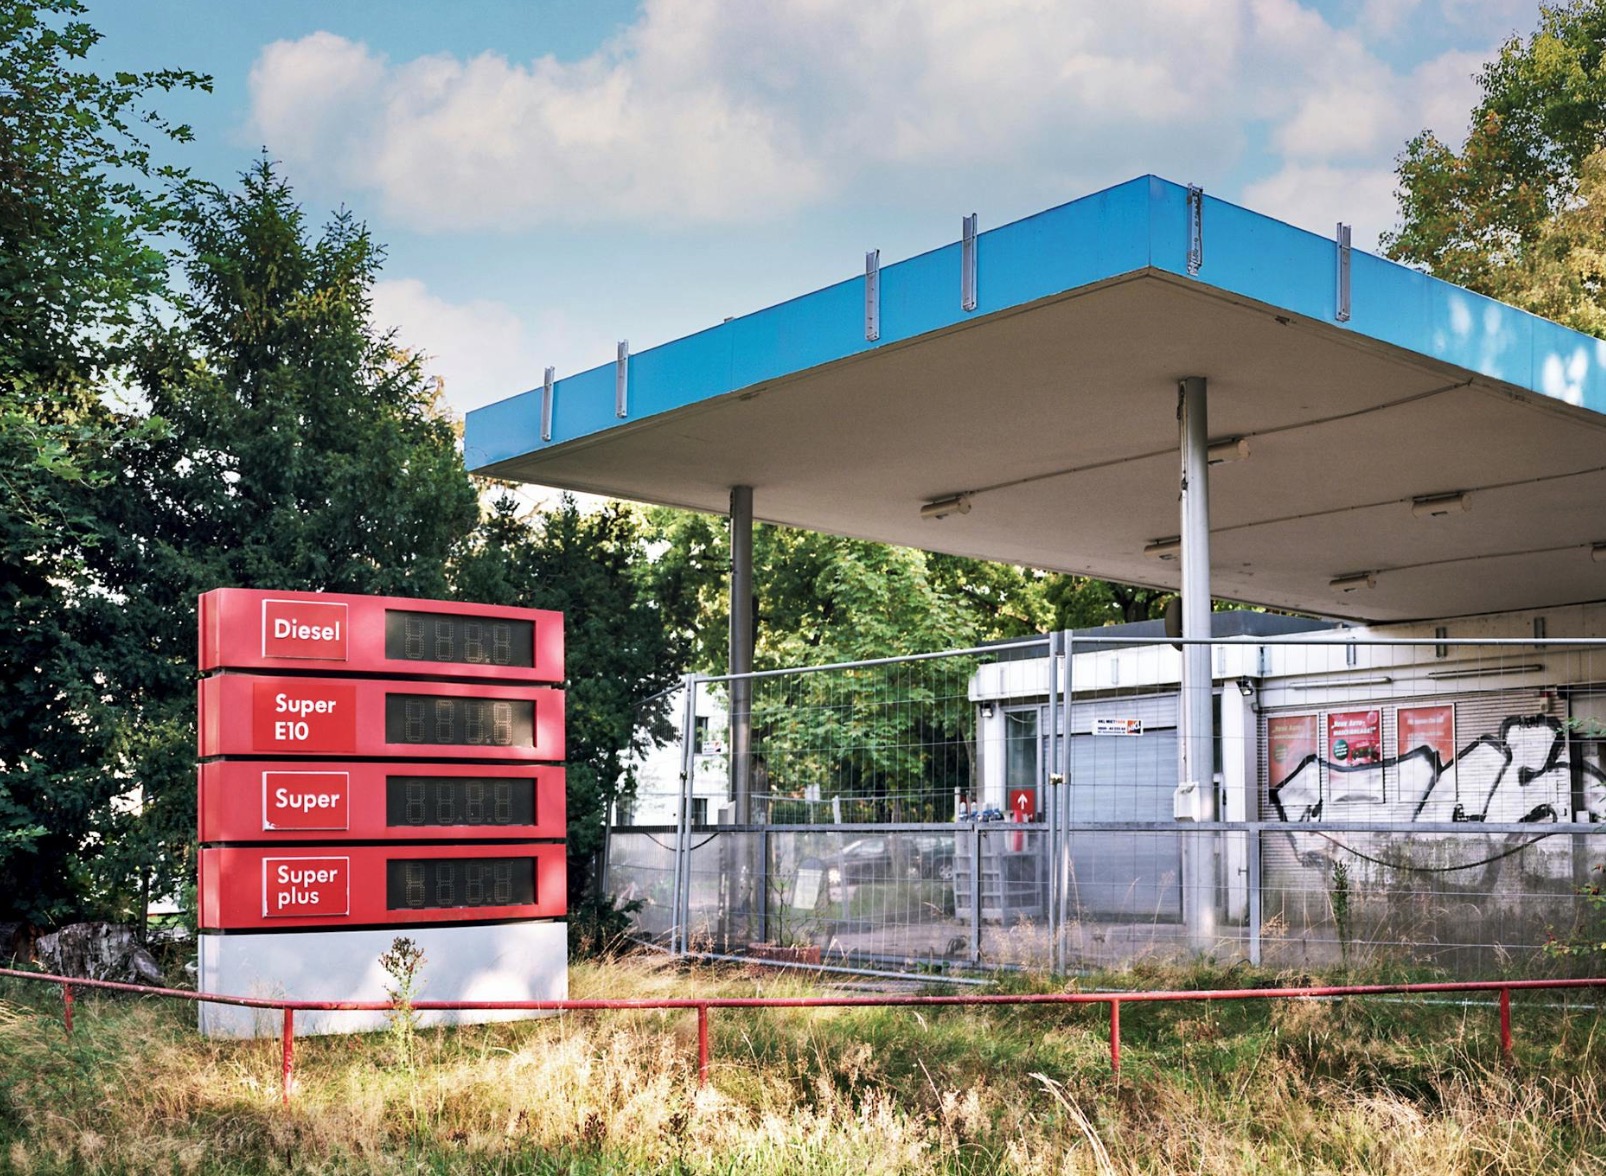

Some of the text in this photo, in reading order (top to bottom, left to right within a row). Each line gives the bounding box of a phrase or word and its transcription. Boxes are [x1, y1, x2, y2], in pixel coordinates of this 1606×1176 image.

[274, 618, 340, 641] Diesel
[275, 693, 337, 718] Super
[275, 721, 309, 740] E10
[275, 788, 340, 813] Super
[277, 865, 338, 888] Super
[278, 886, 320, 909] plus
